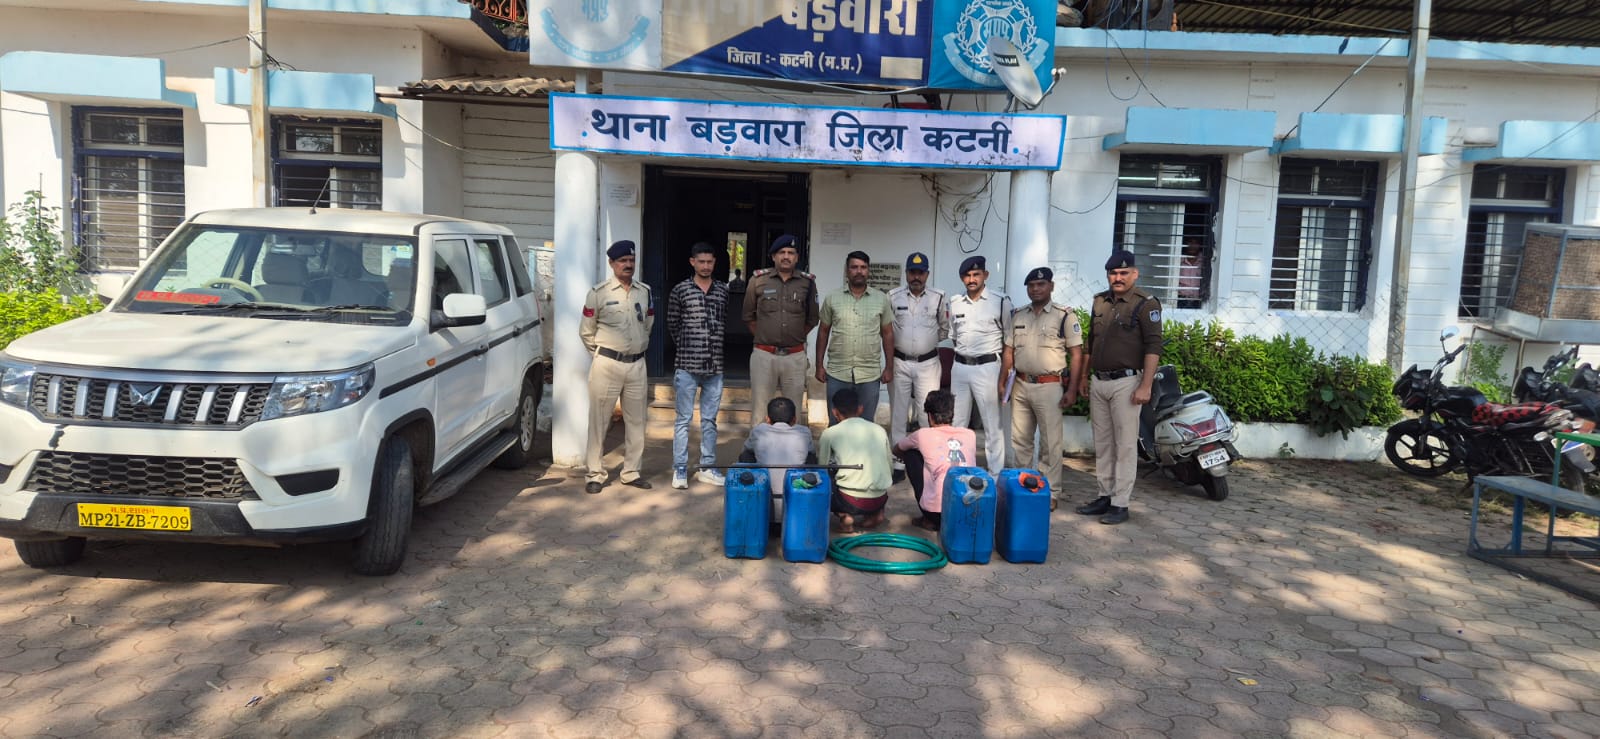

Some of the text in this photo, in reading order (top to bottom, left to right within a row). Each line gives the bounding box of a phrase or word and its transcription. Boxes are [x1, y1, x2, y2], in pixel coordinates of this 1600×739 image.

[780, 0, 921, 42] बड़वारा
[727, 47, 761, 65] जिला
[779, 51, 813, 68] कटनी
[818, 52, 862, 74] (म.प्र.)
[591, 109, 1012, 154] थाना बड़वारा जिला कटनी
[80, 512, 189, 529] MP21-ZB-7209
